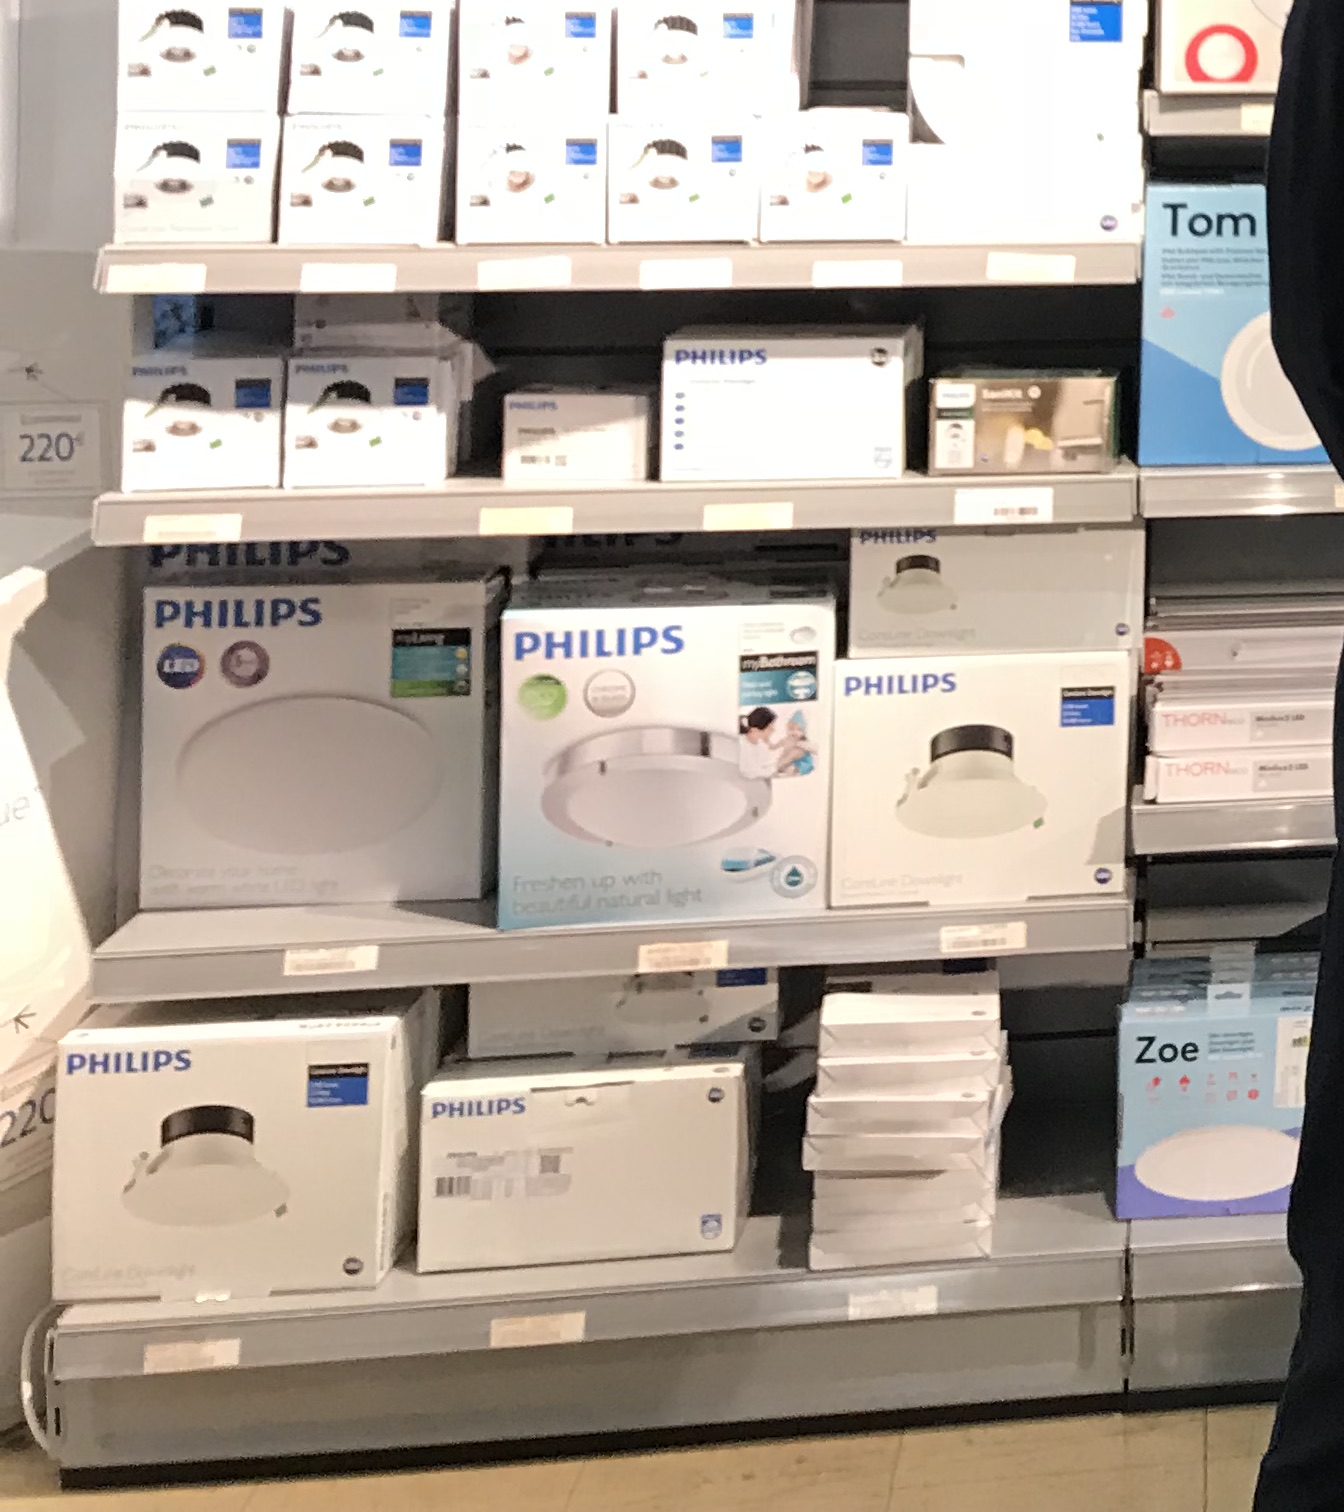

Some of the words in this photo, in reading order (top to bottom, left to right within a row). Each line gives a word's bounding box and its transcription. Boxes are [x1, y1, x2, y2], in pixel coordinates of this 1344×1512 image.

[1162, 203, 1256, 237] Tom
[674, 349, 767, 365] PHILIPS
[509, 401, 558, 411] PHILIPS
[859, 529, 937, 545] PHILIPS
[149, 540, 351, 568] PHILIPS
[155, 597, 322, 628] PHILIPS
[514, 625, 685, 661] PHILIPS
[844, 672, 957, 696] PHILIPS
[1162, 712, 1227, 727] THORN
[1165, 761, 1231, 777] THORN
[513, 874, 586, 893] Freshen
[591, 875, 615, 895] up
[623, 869, 663, 886] with
[512, 894, 590, 916] beautiful
[599, 890, 662, 910] natural
[668, 887, 702, 909] light
[66, 1049, 192, 1075] PHILIPS
[1135, 1035, 1200, 1064] Zoe
[431, 1096, 527, 1120] PHILIPS
